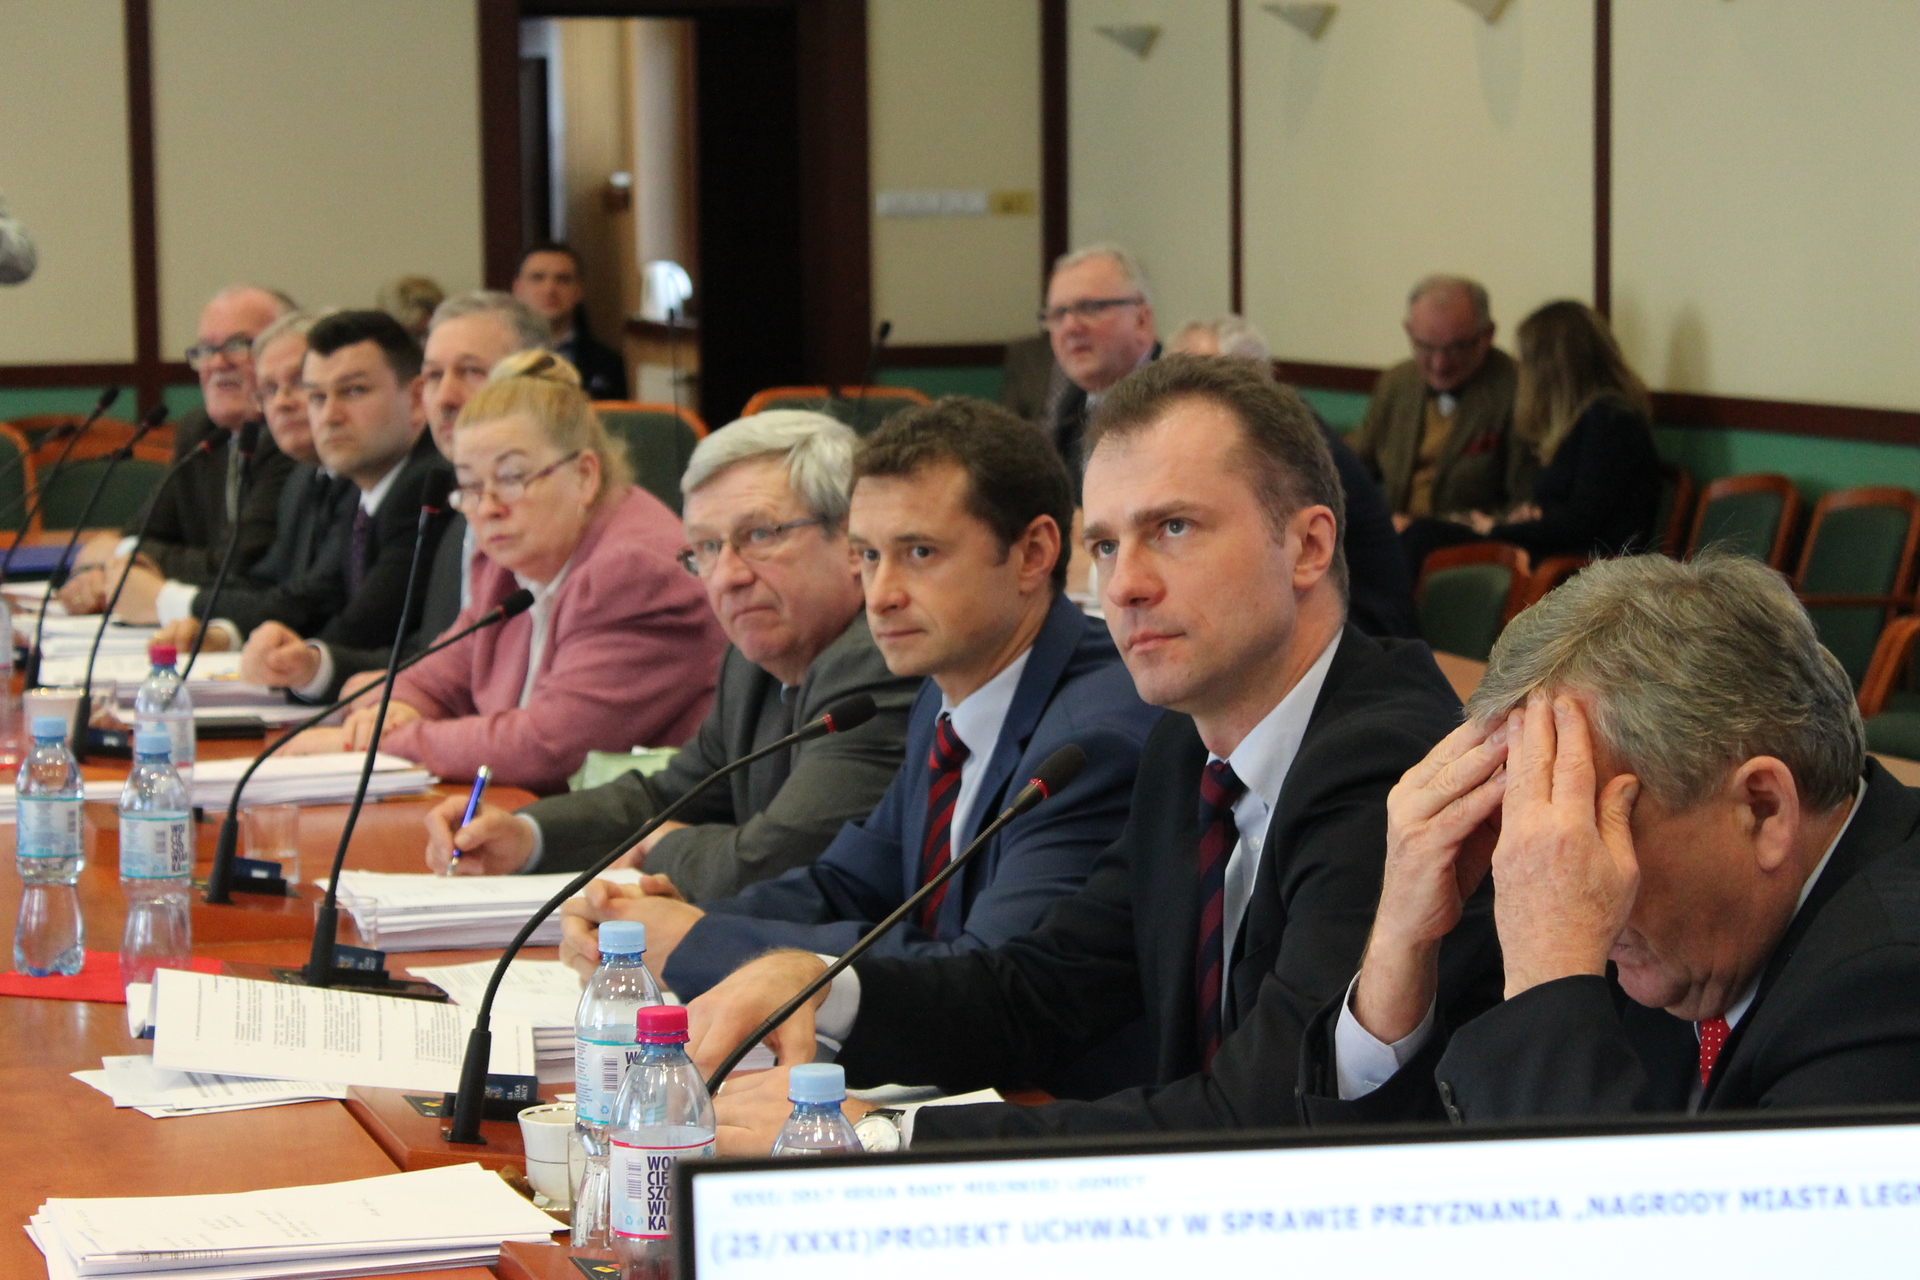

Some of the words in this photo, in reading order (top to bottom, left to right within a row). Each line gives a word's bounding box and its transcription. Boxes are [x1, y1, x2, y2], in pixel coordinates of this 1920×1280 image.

[647, 1156, 677, 1171] WO
[647, 1171, 669, 1186] CIE
[1182, 1212, 1210, 1237] W
[1221, 1204, 1360, 1236] SPRAWIE
[1372, 1197, 1561, 1227] PRZYZNANIA
[1739, 1184, 1850, 1214] MIASTA
[1860, 1180, 1920, 1208] LEG
[648, 1216, 667, 1231] KA
